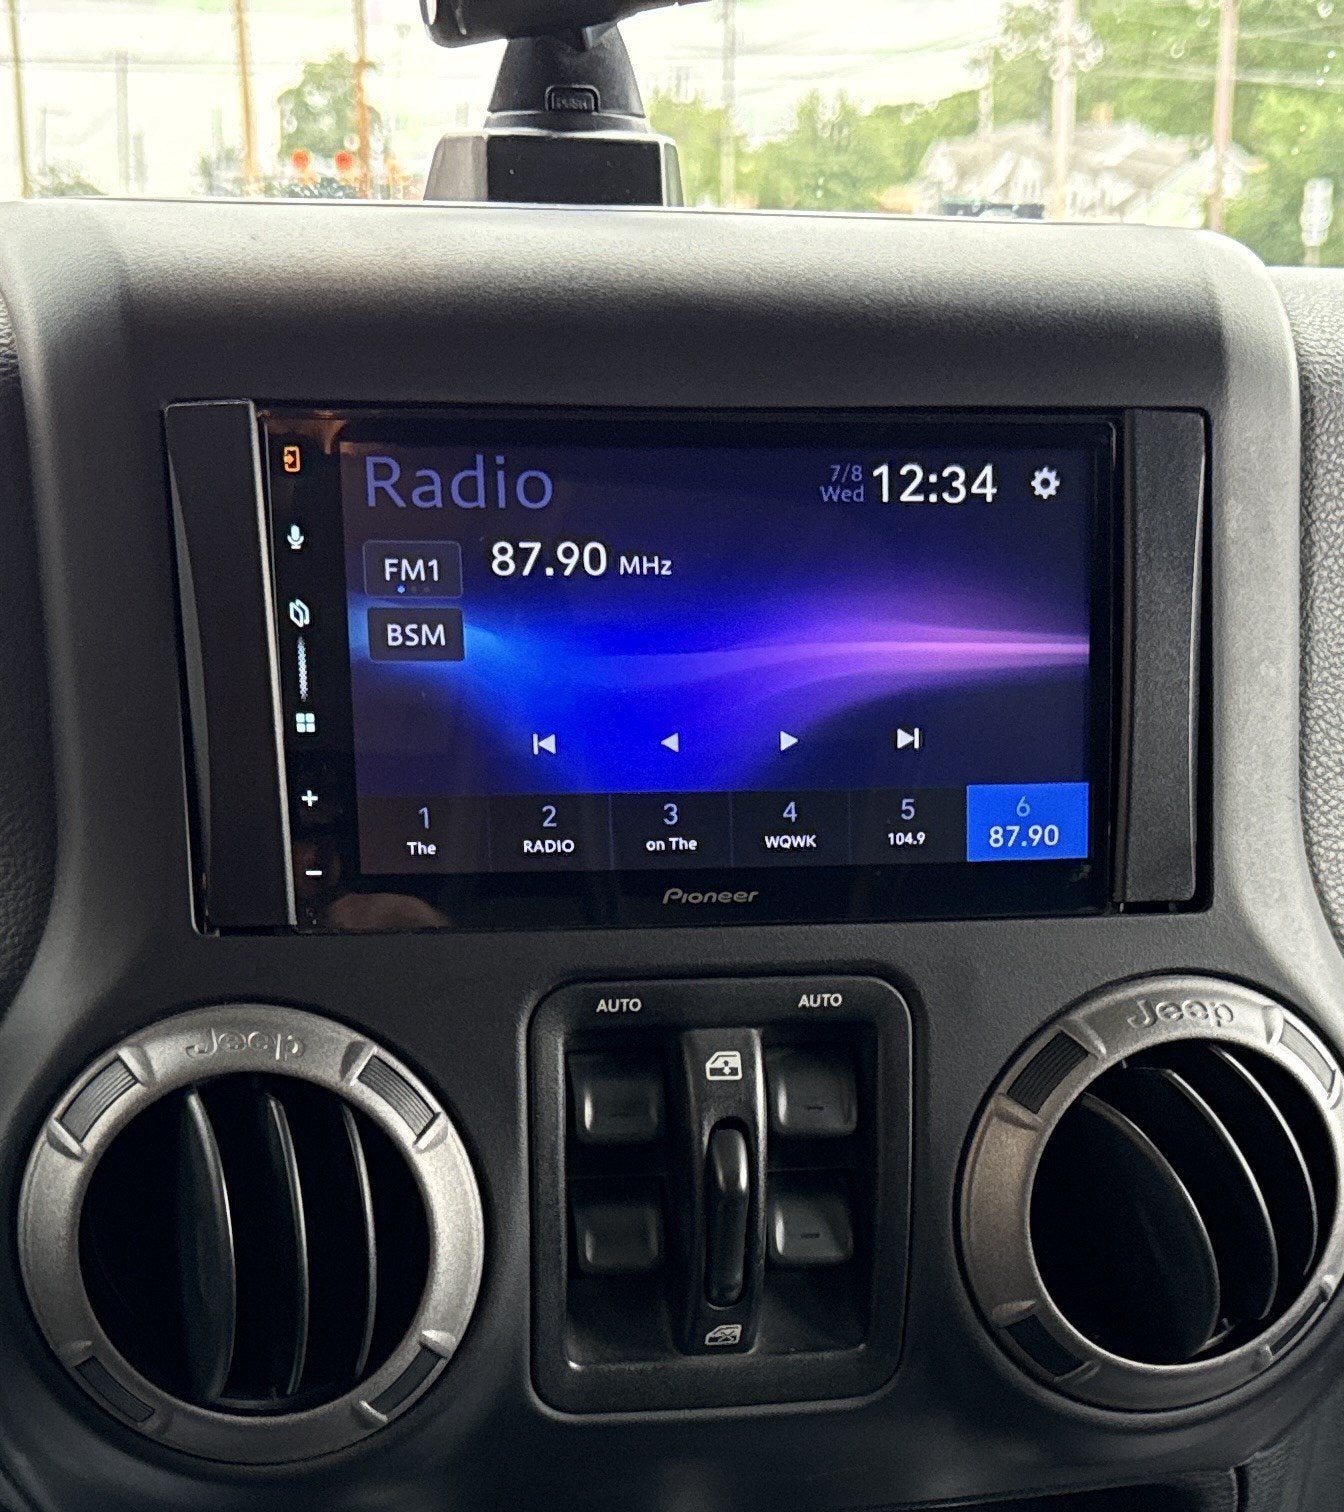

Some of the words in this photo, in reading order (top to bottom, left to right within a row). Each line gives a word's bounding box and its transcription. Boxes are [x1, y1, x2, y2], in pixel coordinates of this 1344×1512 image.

[365, 453, 553, 509] Radio
[830, 464, 863, 483] 7/8
[873, 463, 998, 504] 12:34
[820, 485, 865, 503] Wed
[492, 541, 607, 576] 87.90
[619, 556, 672, 576] MHz
[384, 558, 439, 582] FM1
[387, 623, 445, 646] BSM
[418, 807, 430, 829] 1
[542, 805, 557, 828] 2
[663, 803, 679, 826] 3
[782, 801, 798, 823] 4
[901, 798, 916, 821] 5
[1016, 796, 1031, 818] 6
[407, 840, 437, 856] The
[523, 838, 575, 854] RADIO
[646, 839, 666, 852] on
[669, 836, 698, 851] The
[764, 834, 817, 850] WQWK
[888, 831, 926, 846] 104.9
[989, 825, 1060, 849] 87.90
[662, 887, 759, 905] Pioneer
[596, 998, 642, 1013] AUTO
[798, 993, 843, 1009] AUTO
[1126, 999, 1234, 1031] Jeep
[185, 1027, 306, 1062] Jeep
